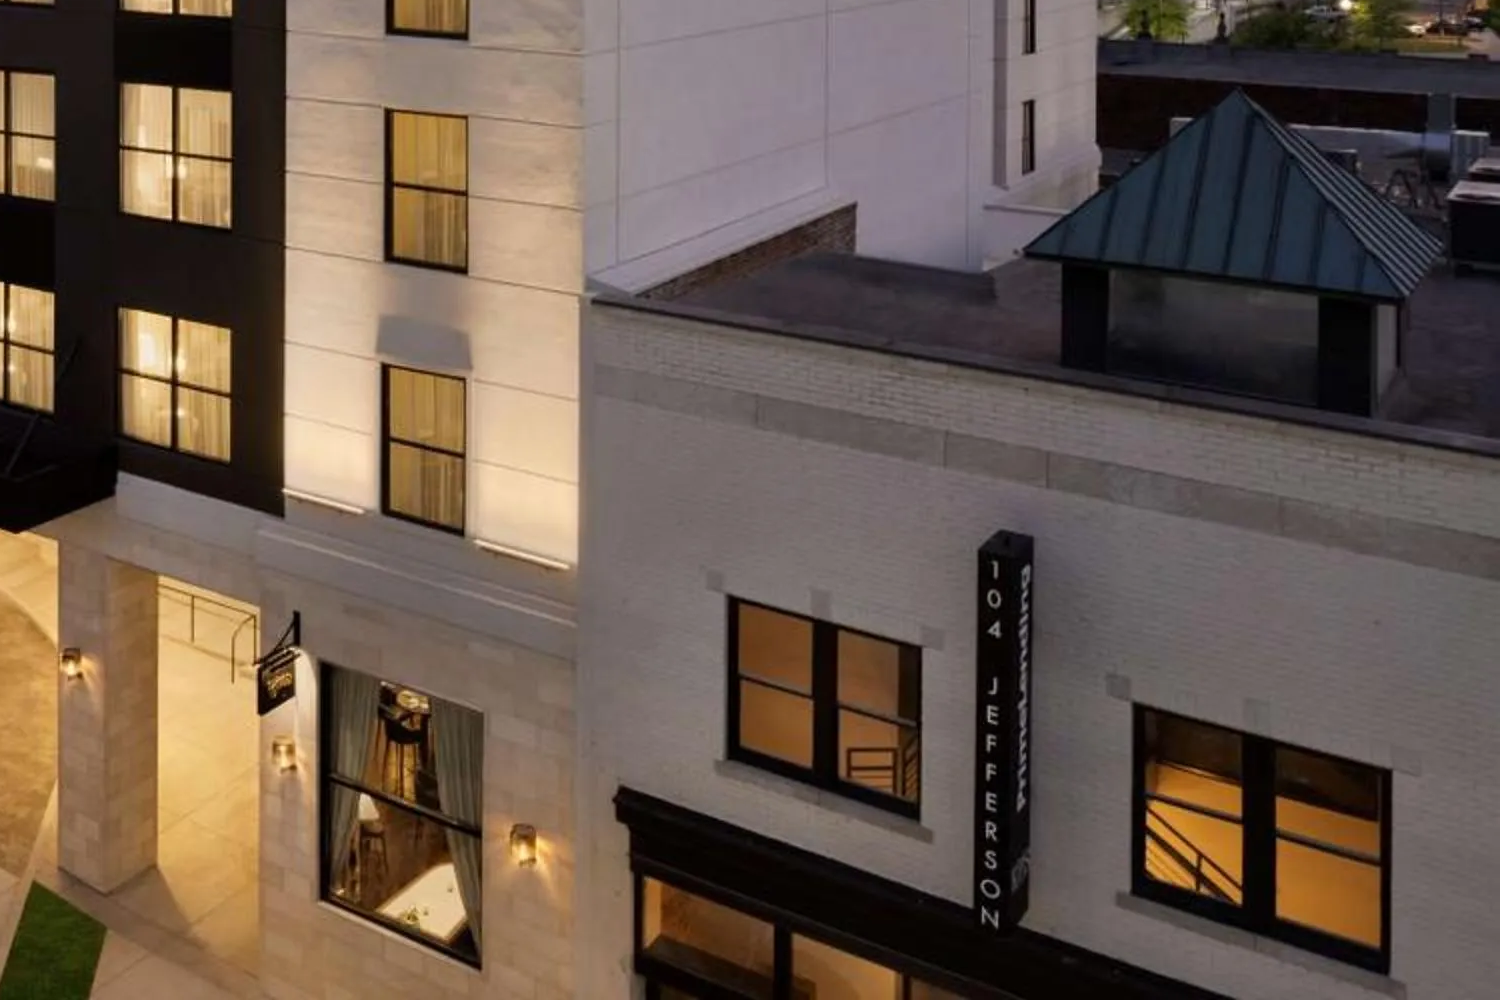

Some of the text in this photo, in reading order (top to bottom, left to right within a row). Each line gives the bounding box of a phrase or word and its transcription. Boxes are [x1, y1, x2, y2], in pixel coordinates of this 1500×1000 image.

[979, 559, 1002, 930] 104 JEFFERSON
[1016, 563, 1032, 814] PrimeLending
